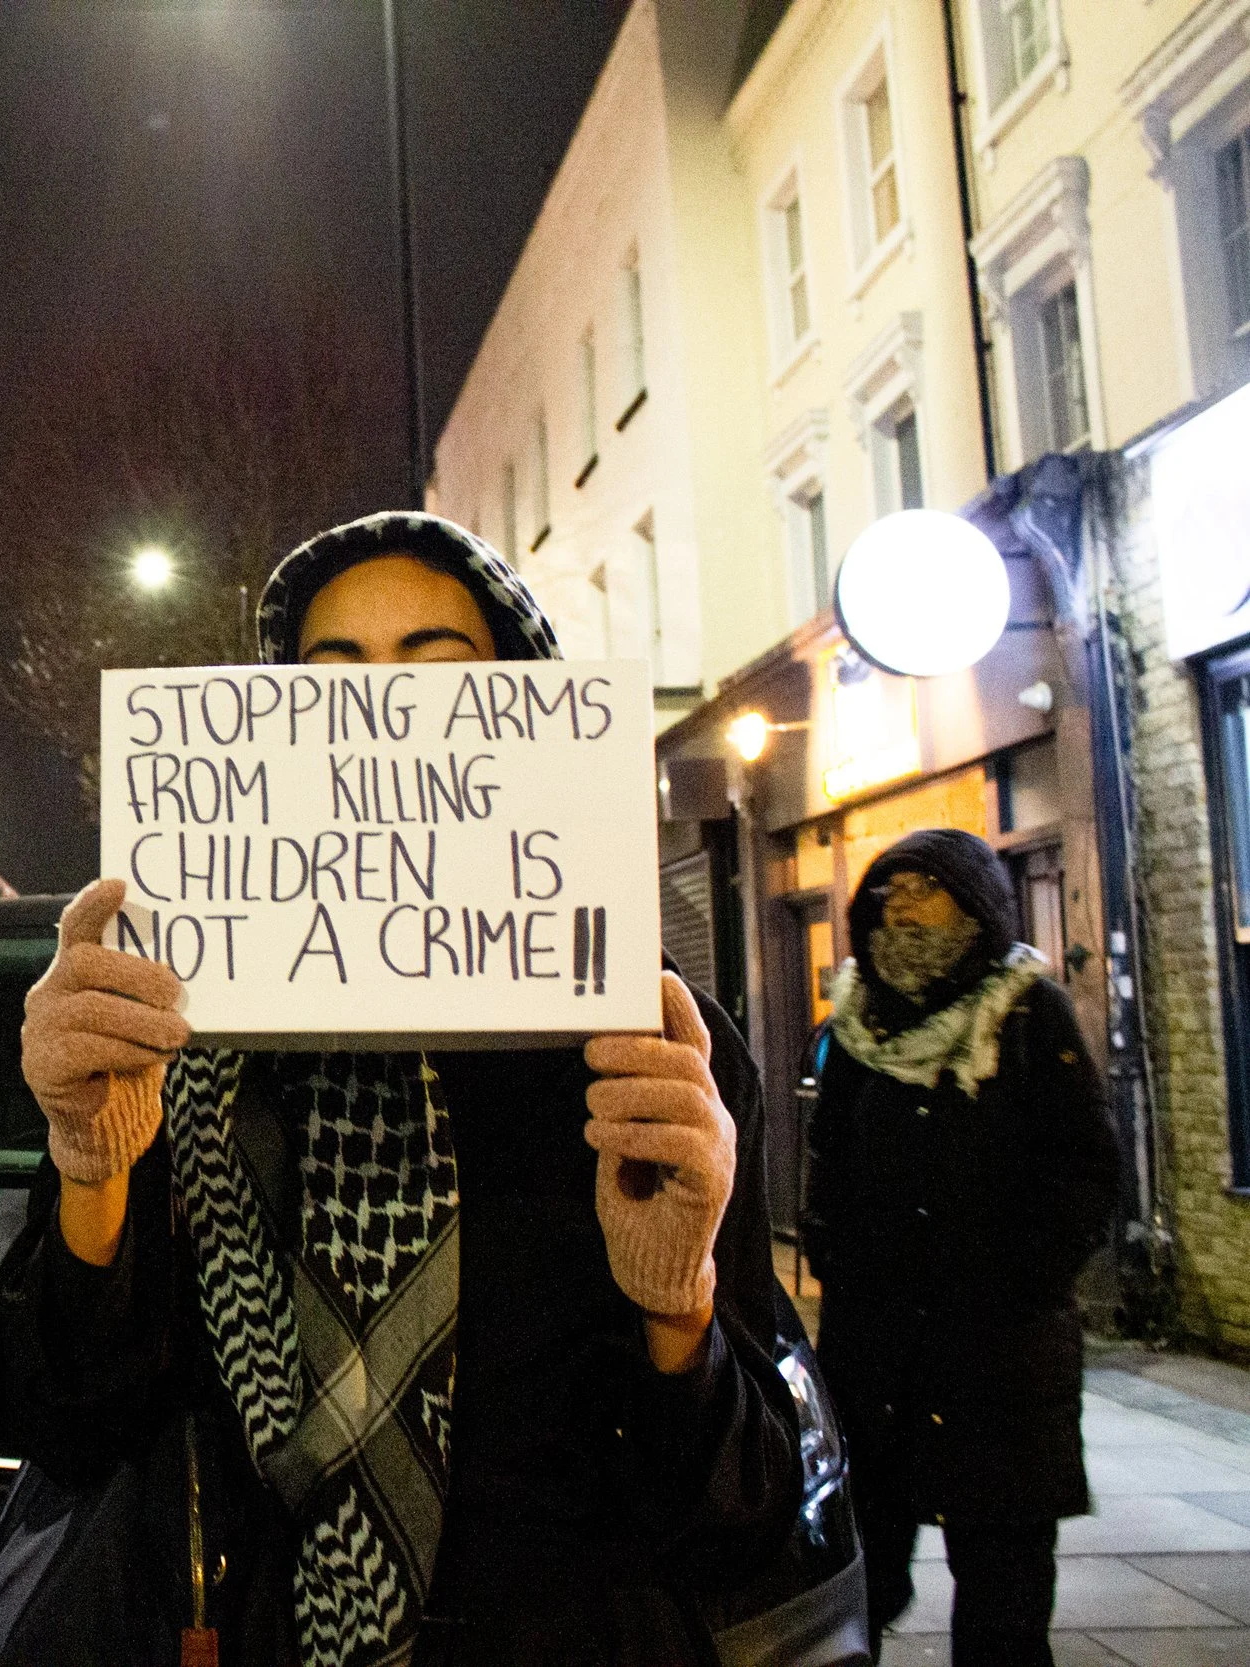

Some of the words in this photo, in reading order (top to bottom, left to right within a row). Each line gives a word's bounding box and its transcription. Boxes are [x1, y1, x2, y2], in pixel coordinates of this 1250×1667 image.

[128, 673, 415, 746] STOPPING
[445, 673, 611, 740] ARMS
[126, 752, 268, 824] FROM
[329, 753, 500, 824] KILLING
[131, 831, 435, 902] CHILDREN
[511, 831, 562, 900] IS
[117, 910, 248, 982] NOT
[288, 903, 347, 984] A
[379, 904, 606, 996] CRIME!!
